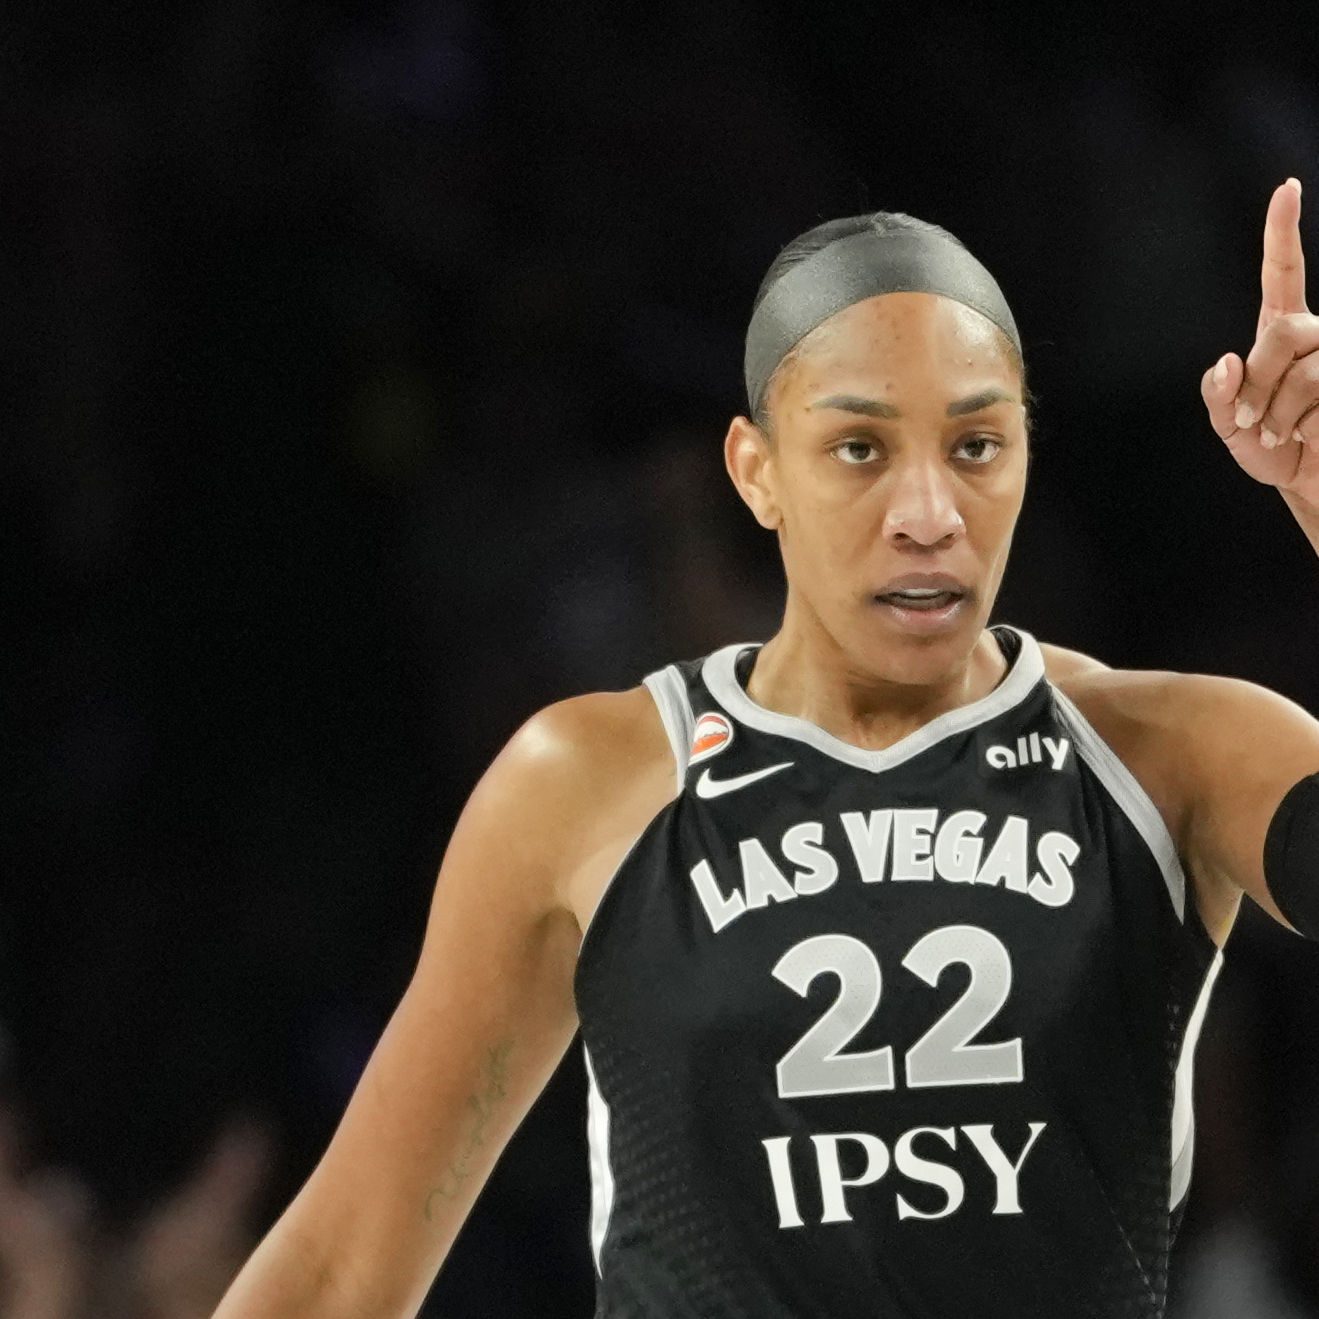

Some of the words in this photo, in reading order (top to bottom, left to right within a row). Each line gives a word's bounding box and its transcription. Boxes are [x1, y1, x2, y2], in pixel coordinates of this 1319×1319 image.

[985, 731, 1069, 770] ally
[689, 822, 838, 933] LAS
[840, 808, 1081, 907] VEGAS
[771, 925, 1024, 1099] 22
[761, 1121, 1047, 1229] IPSY
